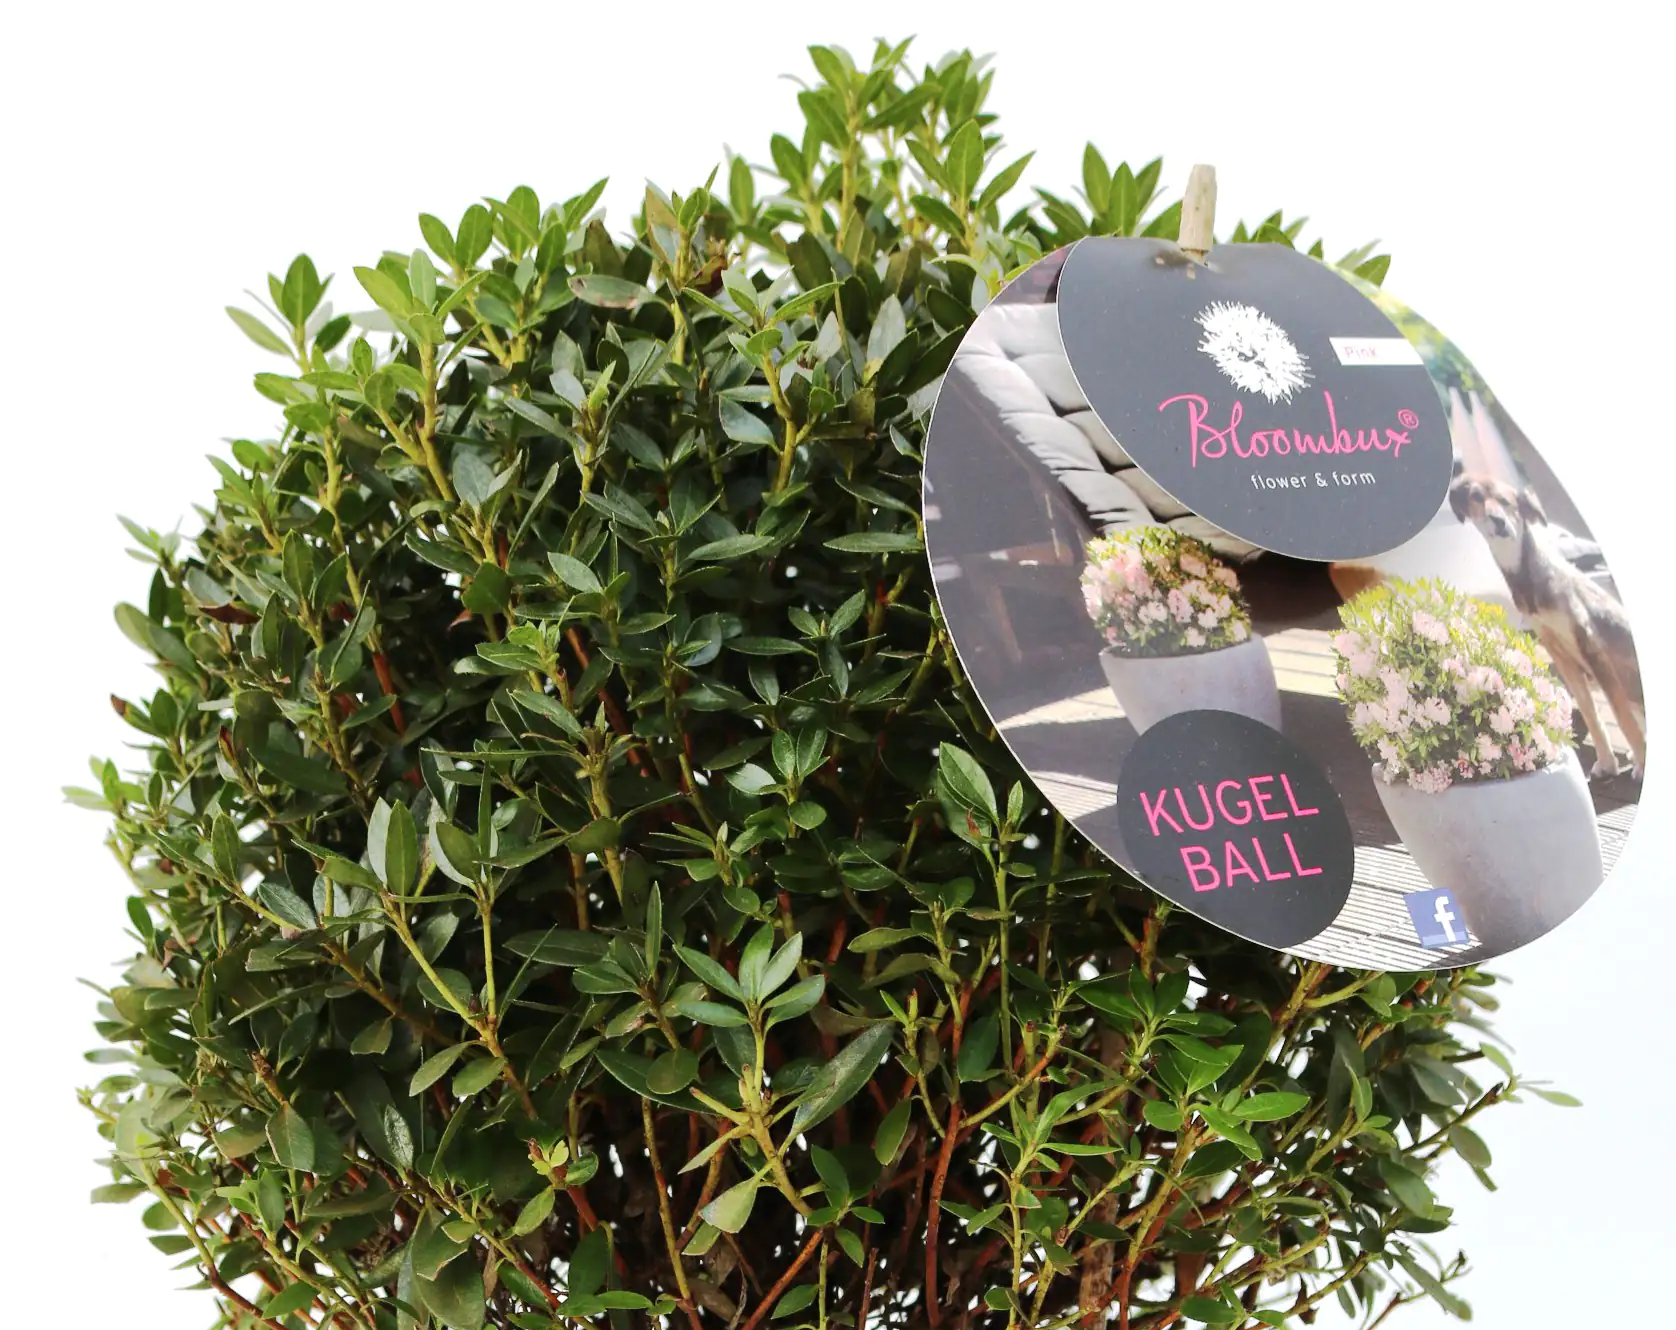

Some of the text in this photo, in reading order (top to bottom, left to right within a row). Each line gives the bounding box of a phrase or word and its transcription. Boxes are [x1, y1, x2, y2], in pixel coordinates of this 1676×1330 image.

[1251, 471, 1376, 490] flower & form
[1139, 773, 1320, 837] KUGEL
[1179, 832, 1323, 892] BALL
